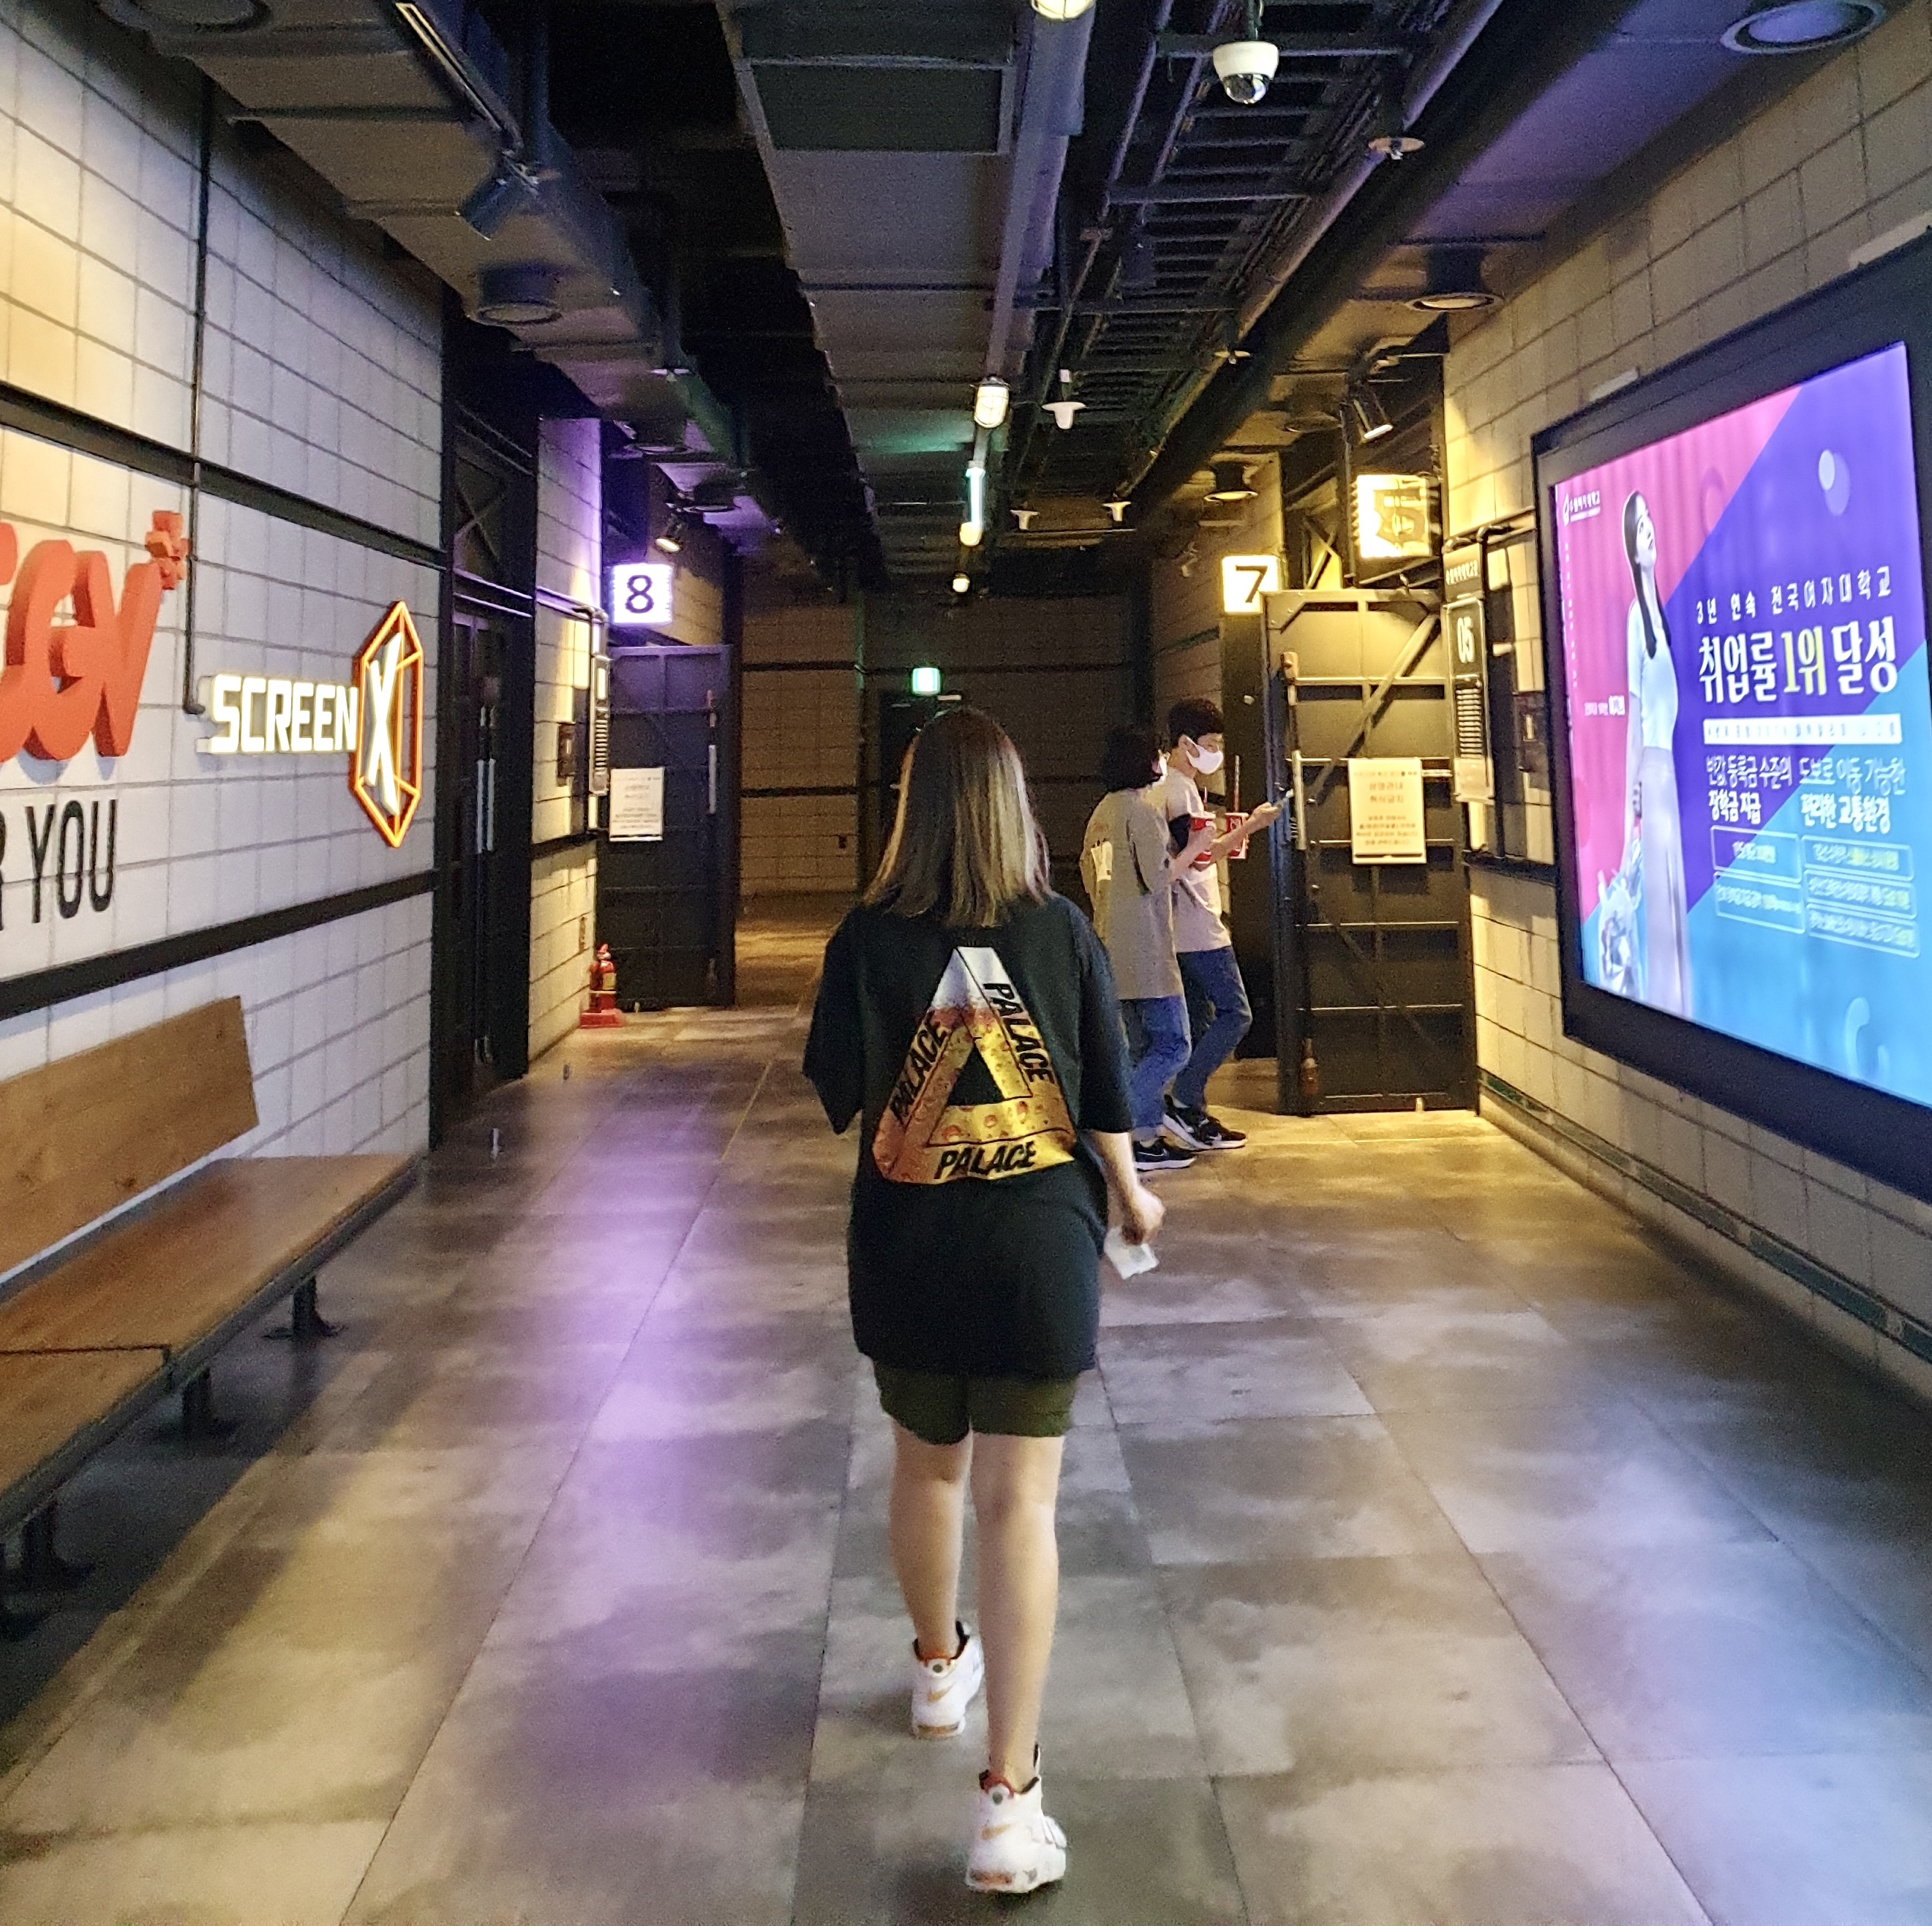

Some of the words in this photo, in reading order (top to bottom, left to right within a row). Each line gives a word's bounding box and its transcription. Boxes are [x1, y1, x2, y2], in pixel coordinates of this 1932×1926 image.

[625, 574, 654, 614] 8
[1235, 565, 1268, 603] 7
[1696, 598, 1717, 625] 3년
[1730, 590, 1756, 621] 연속
[1770, 565, 1891, 615] 전국여자대학교
[1699, 631, 1778, 703] 취업률
[1781, 625, 1827, 696] 1위
[1830, 616, 1898, 695] 달성
[26, 800, 118, 925] YOU
[982, 982, 1055, 1084] PALACE
[933, 1140, 1037, 1180] PALACE
